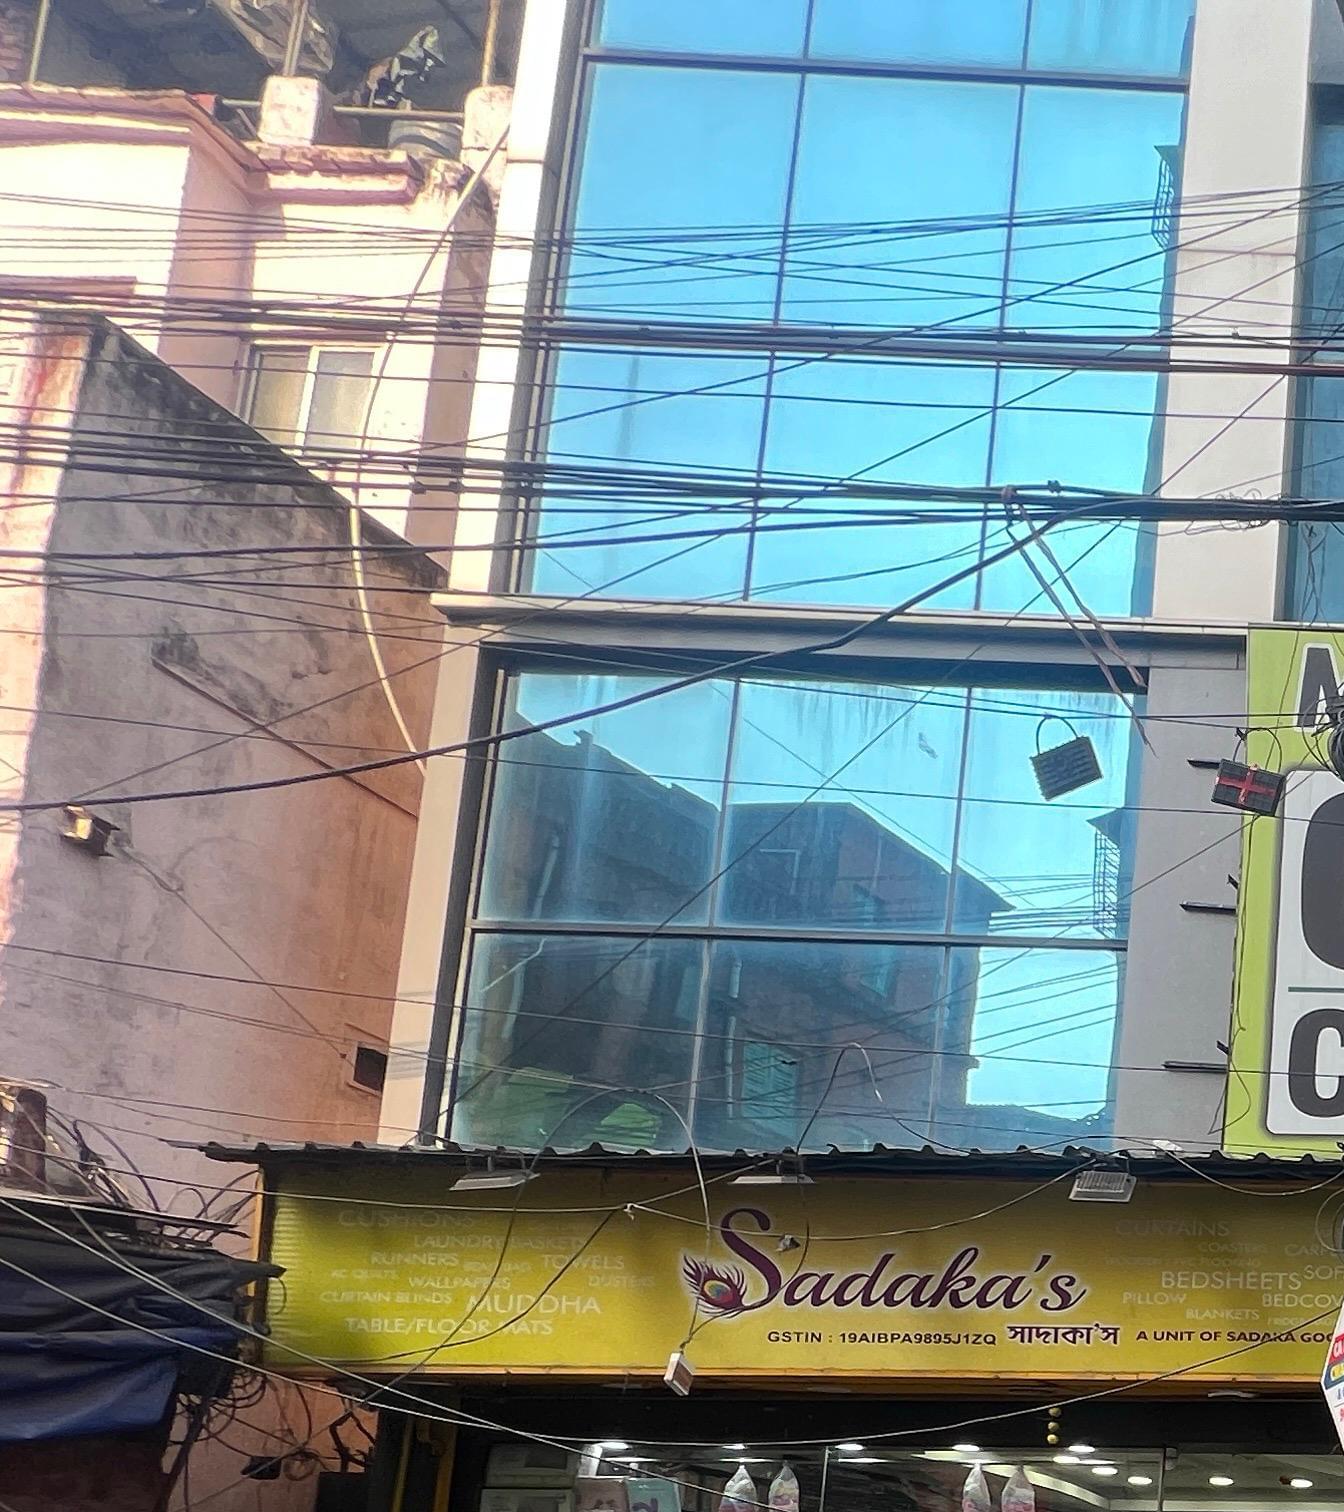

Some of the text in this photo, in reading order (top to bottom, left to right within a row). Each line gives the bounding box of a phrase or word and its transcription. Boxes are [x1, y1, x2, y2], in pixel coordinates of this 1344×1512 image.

[712, 1207, 1088, 1313] Sadaka's
[1161, 1271, 1302, 1291] BEDSHEETS
[465, 1294, 602, 1315] MUDDHA
[1122, 1291, 1187, 1305] PILLOW
[1185, 1308, 1259, 1321] BLANKETS
[768, 1331, 822, 1345] GSTIN
[1135, 1331, 1297, 1343] A UNIT OF SADAKA
